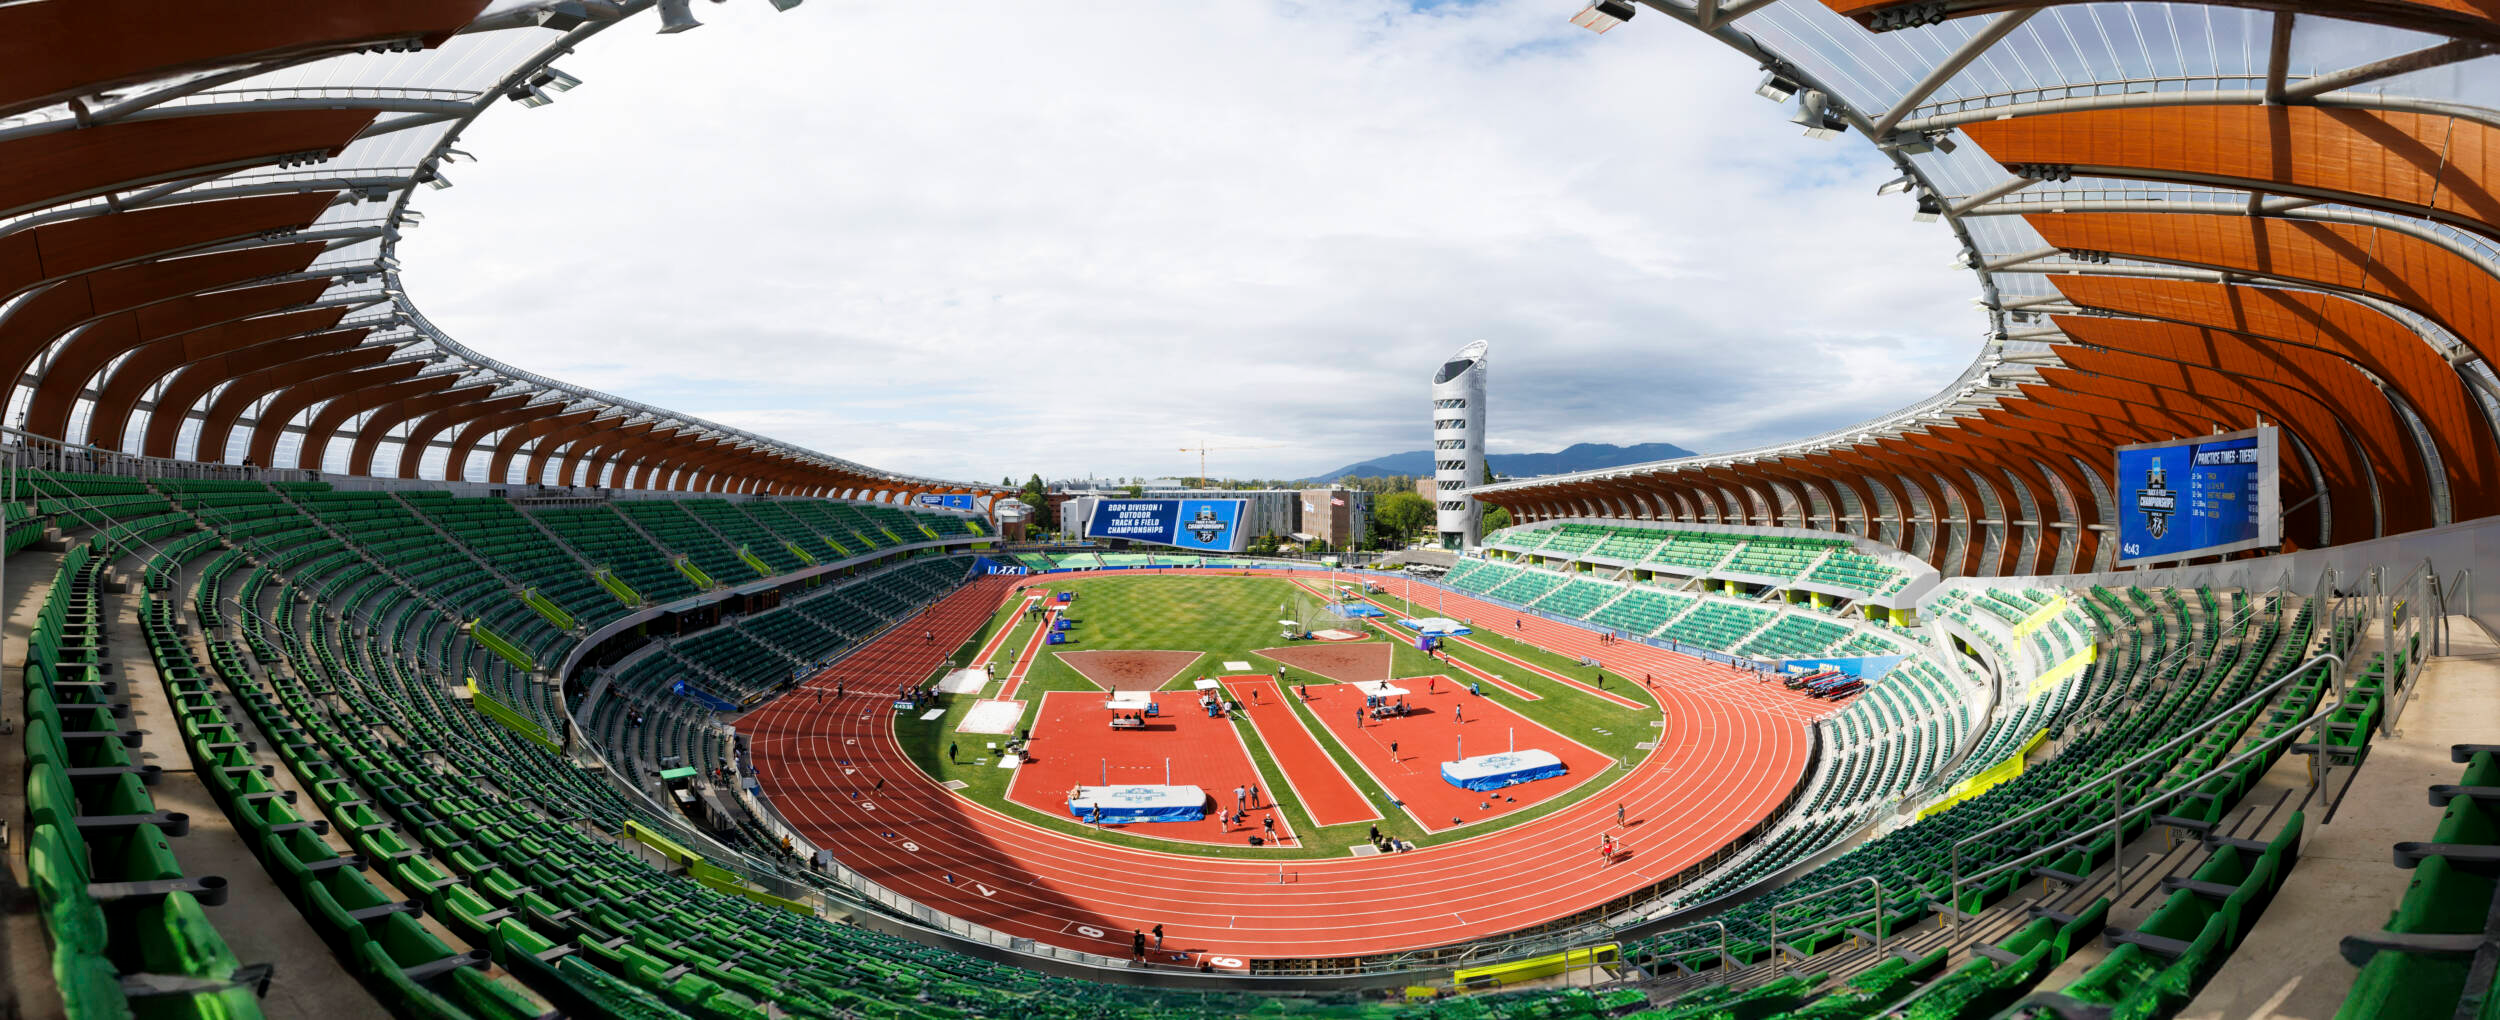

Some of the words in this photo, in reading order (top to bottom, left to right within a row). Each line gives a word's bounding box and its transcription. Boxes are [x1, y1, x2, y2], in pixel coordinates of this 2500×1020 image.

[2198, 451, 2220, 464] PRACTICE
[2220, 449, 2235, 464] TIMES
[2140, 496, 2174, 509] CHAMPIONSHIPS
[1119, 511, 1151, 519] OUTDOOR
[1107, 526, 1164, 534] CHAMPIONSHIPS
[2123, 543, 2140, 556] 4:43
[861, 802, 877, 811] 5
[975, 883, 997, 897] 7
[1077, 925, 1105, 938] 8
